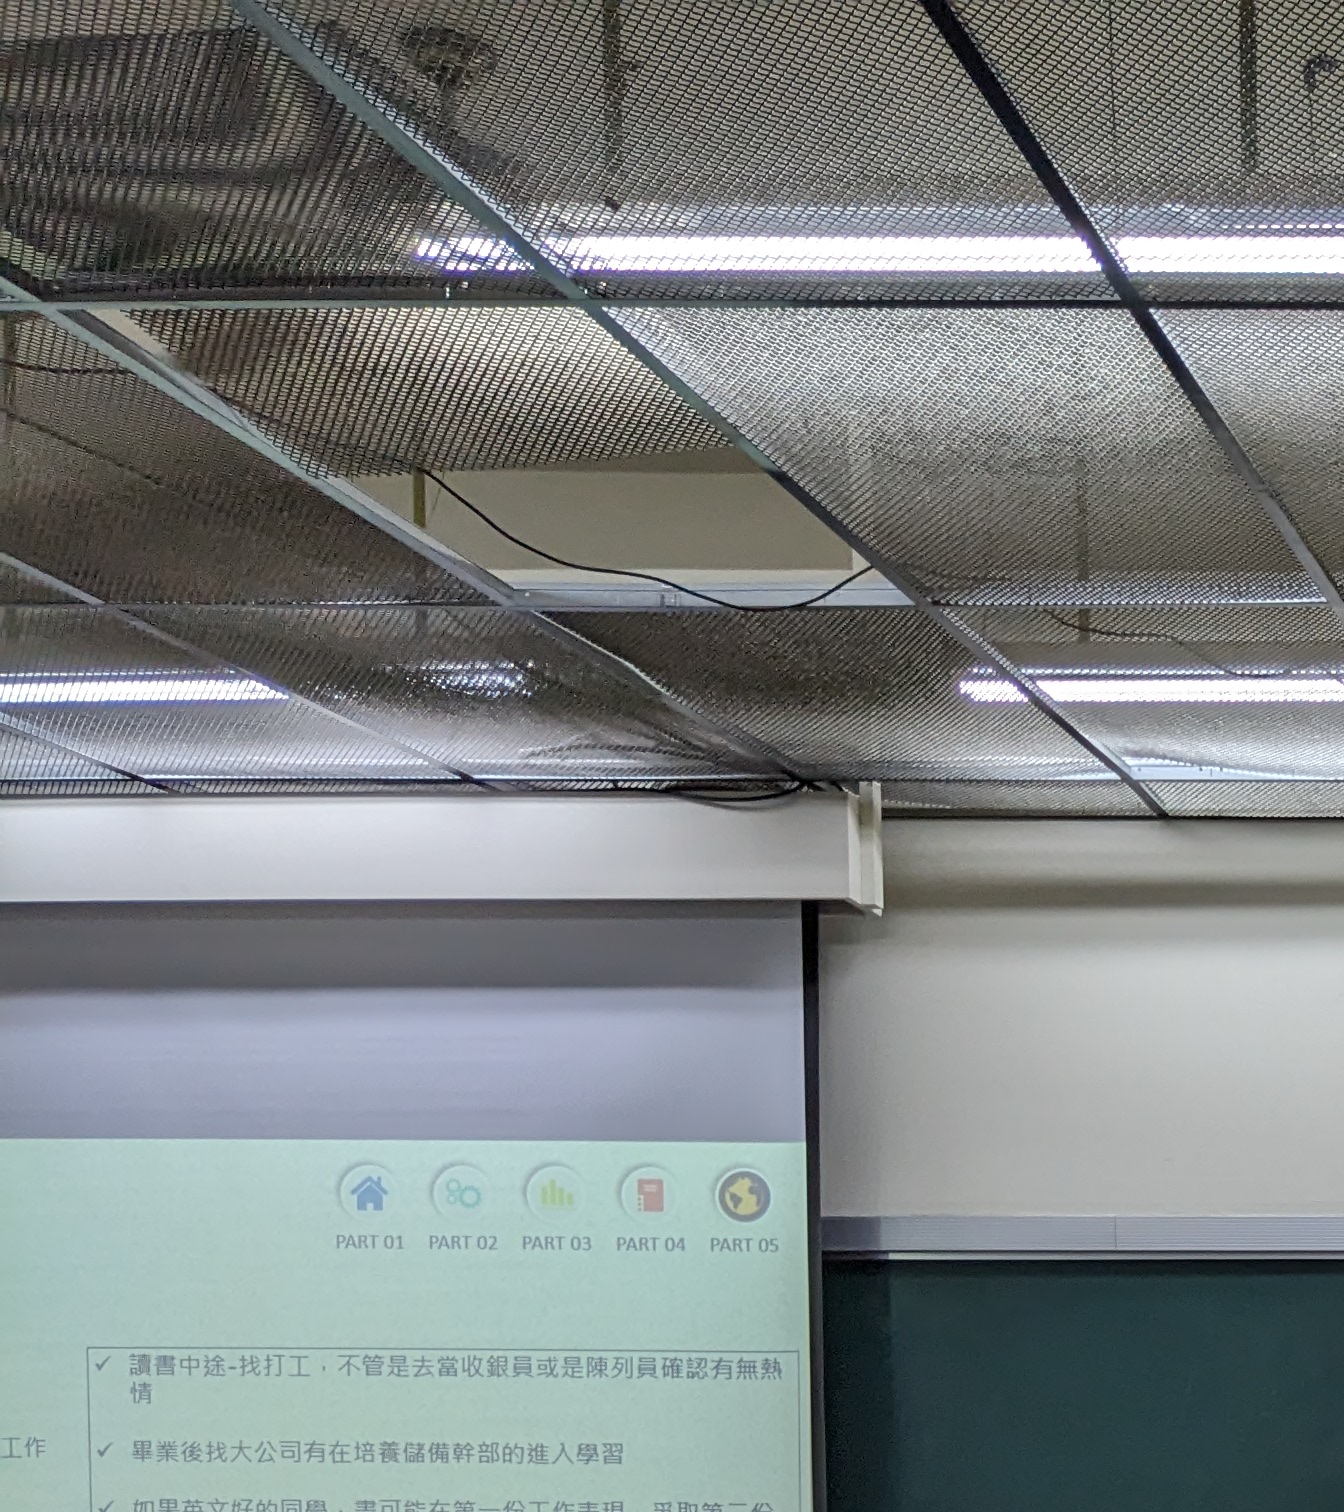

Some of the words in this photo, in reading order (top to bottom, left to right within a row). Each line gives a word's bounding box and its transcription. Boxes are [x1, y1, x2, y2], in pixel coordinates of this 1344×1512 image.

[336, 1234, 380, 1250] PART
[383, 1234, 404, 1250] 01
[429, 1234, 473, 1250] PART
[476, 1235, 498, 1251] 02
[522, 1235, 566, 1251] PART
[570, 1235, 592, 1252] 03
[616, 1236, 661, 1252] PART
[664, 1237, 686, 1252] 04
[710, 1237, 754, 1253] PART
[758, 1237, 779, 1253] 05
[129, 1381, 153, 1405] 情
[0, 1436, 46, 1459] 工作
